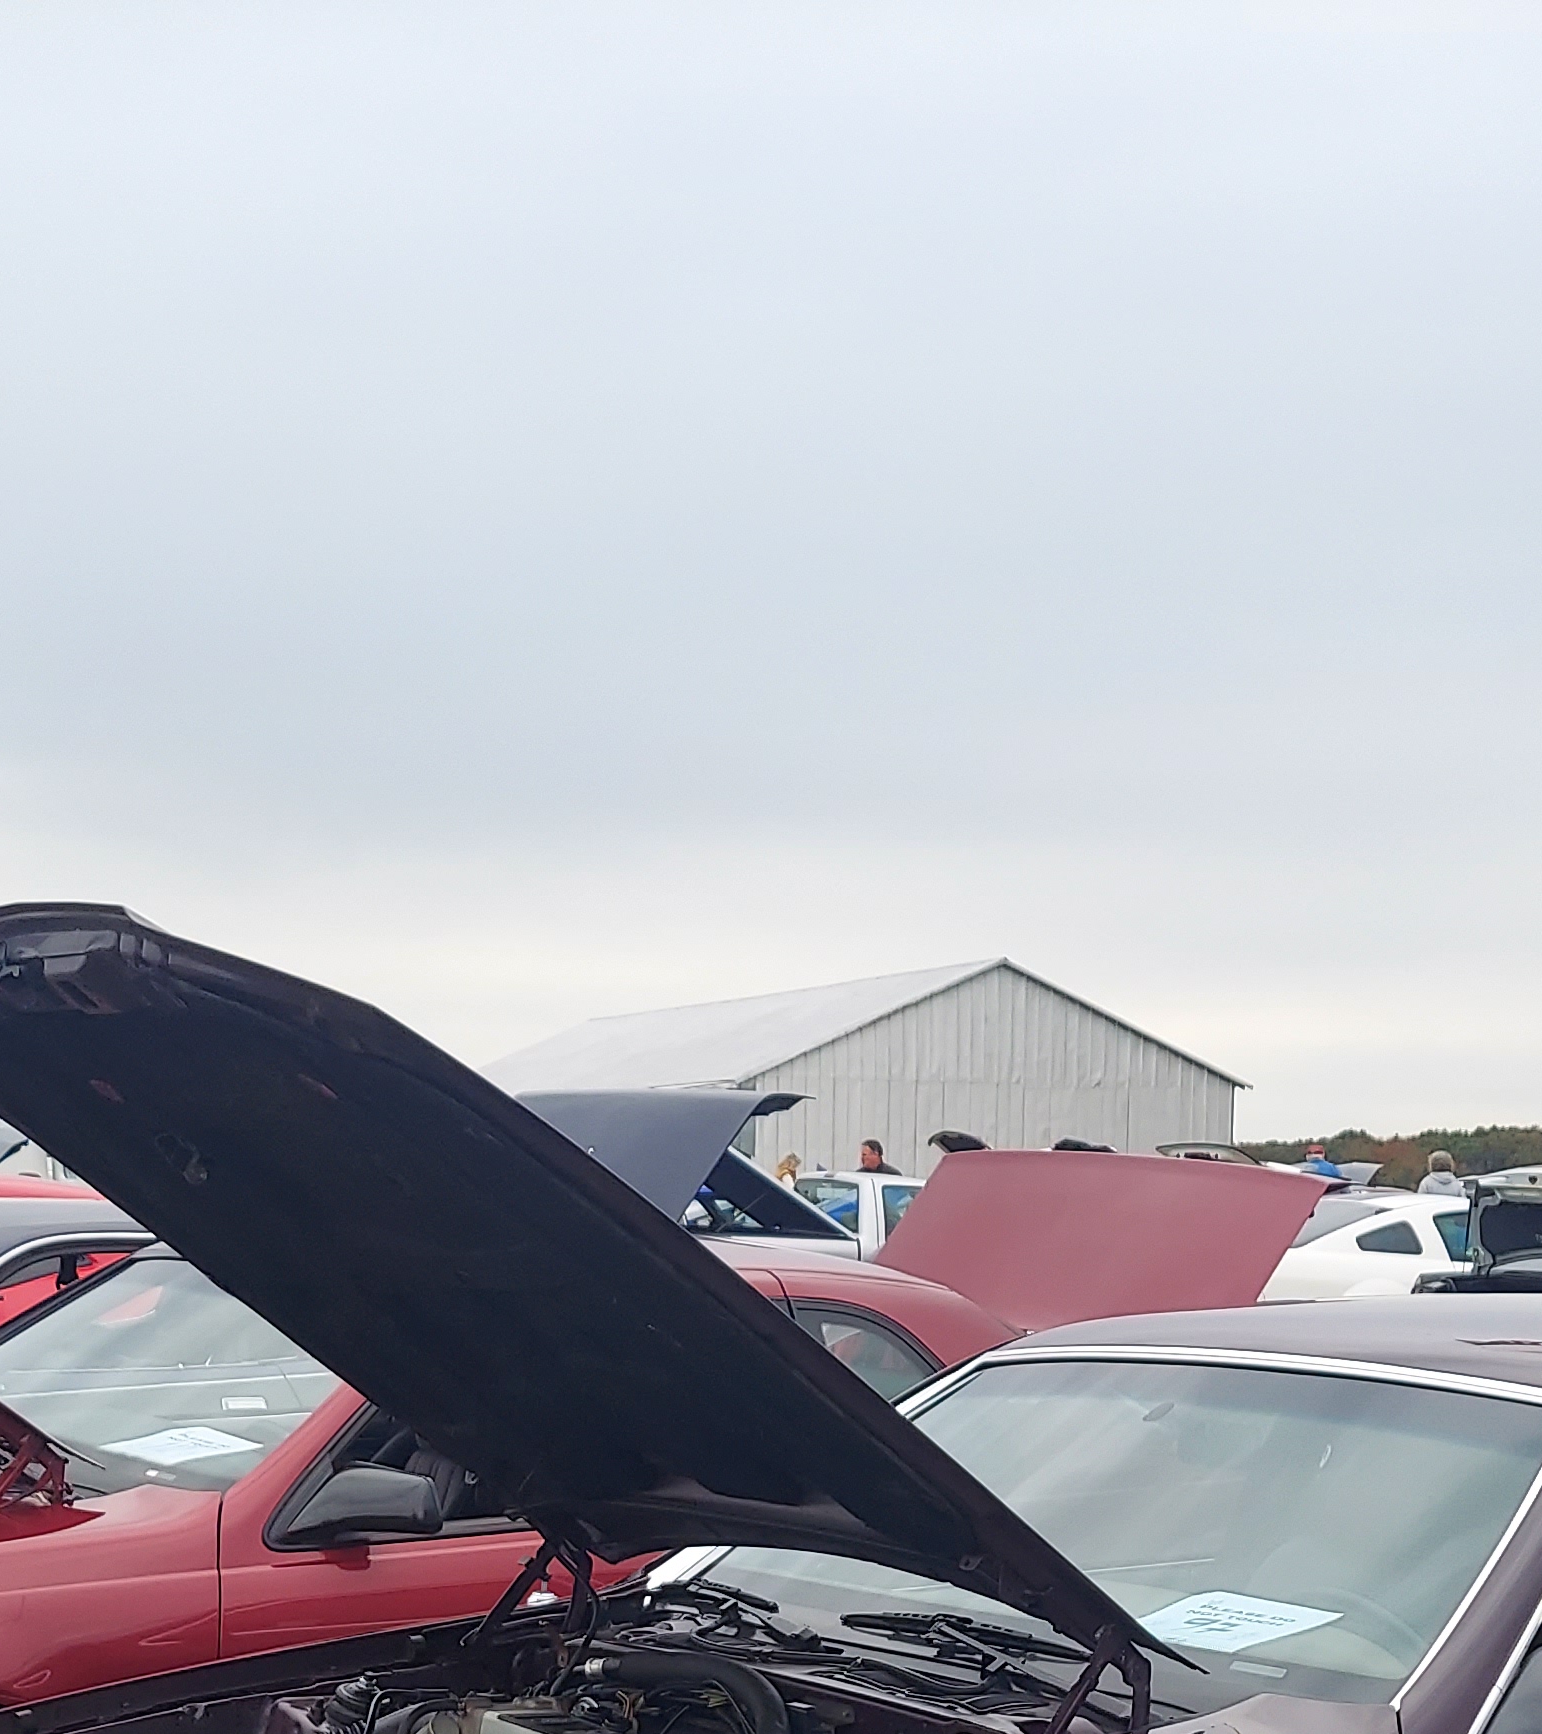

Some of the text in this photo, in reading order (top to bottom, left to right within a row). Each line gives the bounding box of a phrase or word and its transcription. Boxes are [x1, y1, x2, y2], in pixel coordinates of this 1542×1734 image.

[1186, 1608, 1285, 1627] NOT TOUCH
[1199, 1603, 1297, 1623] PLEASE DO
